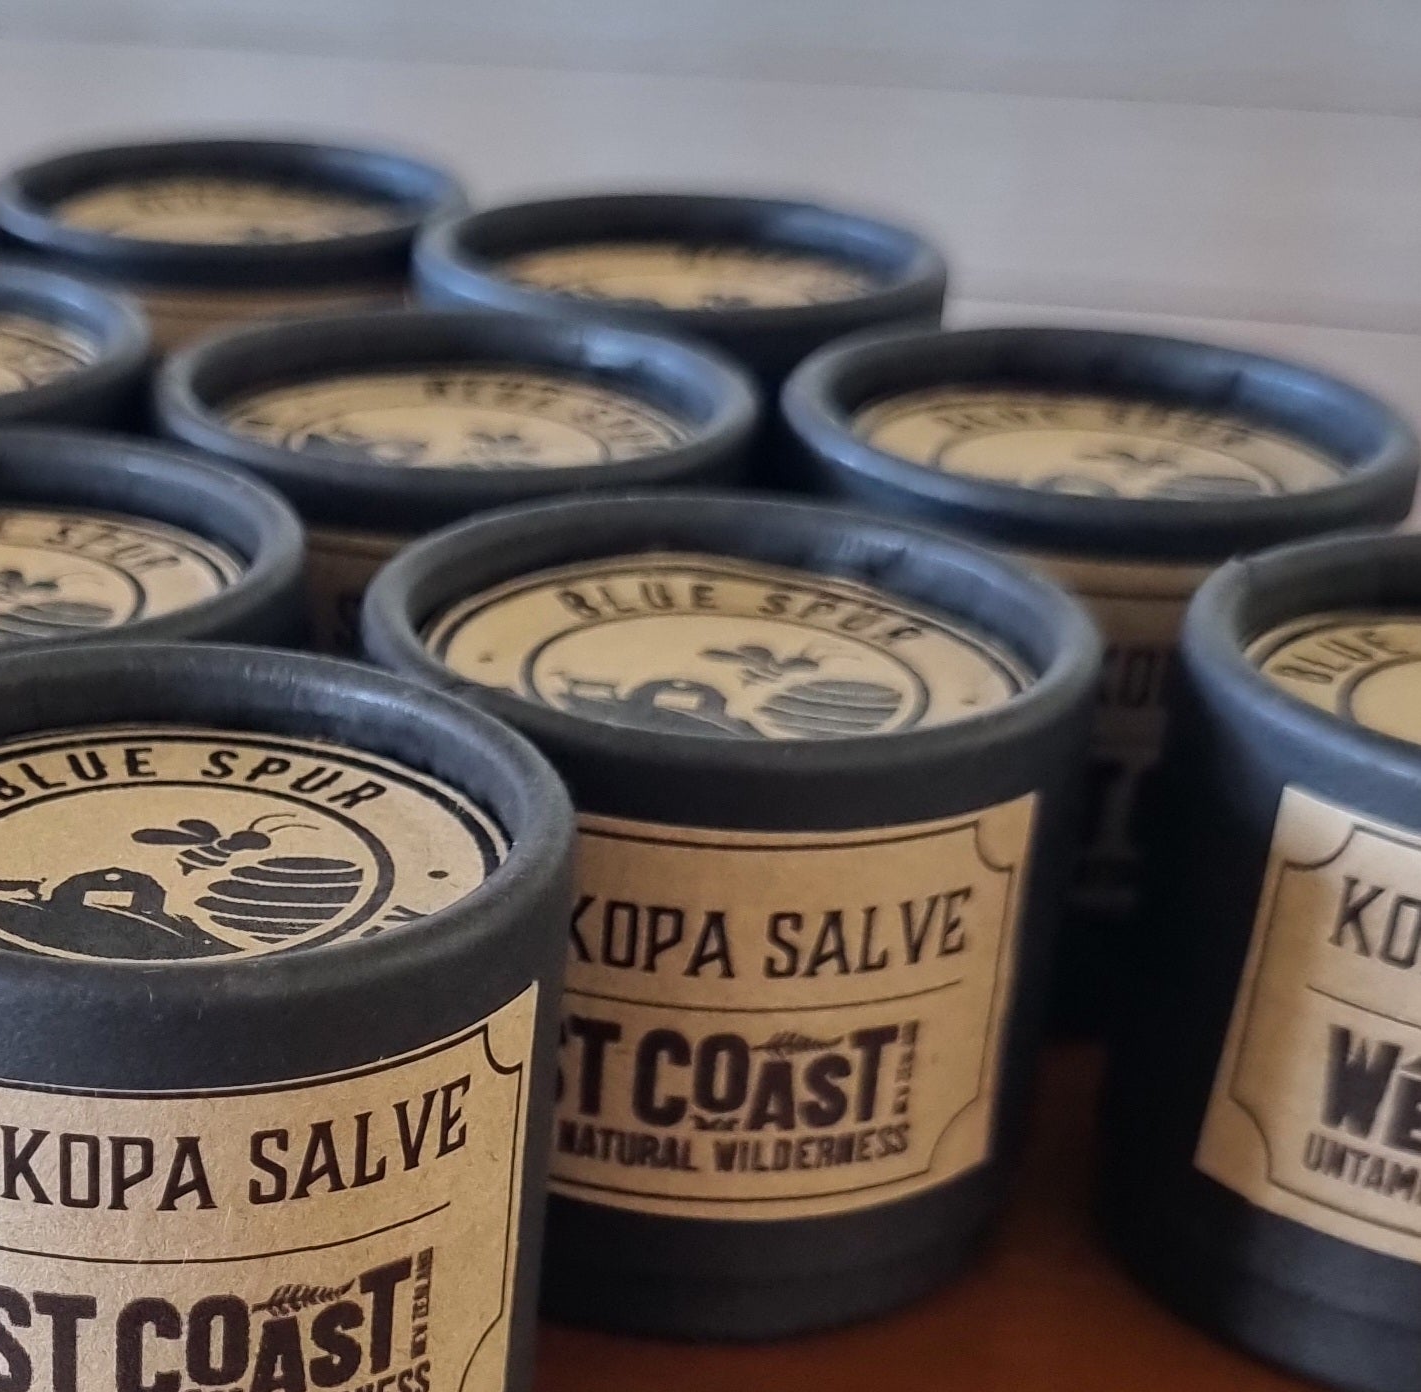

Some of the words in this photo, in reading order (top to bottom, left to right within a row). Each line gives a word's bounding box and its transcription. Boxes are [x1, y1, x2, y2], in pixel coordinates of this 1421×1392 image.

[560, 582, 716, 622] BLUE
[754, 596, 924, 642] SPUR
[200, 748, 390, 810] SPUR
[762, 885, 974, 980] SALVE
[632, 1022, 900, 1133] COAST
[248, 1073, 472, 1204] SALVE
[557, 1118, 697, 1171] NATURAL
[713, 1123, 910, 1174] WILDERNESS
